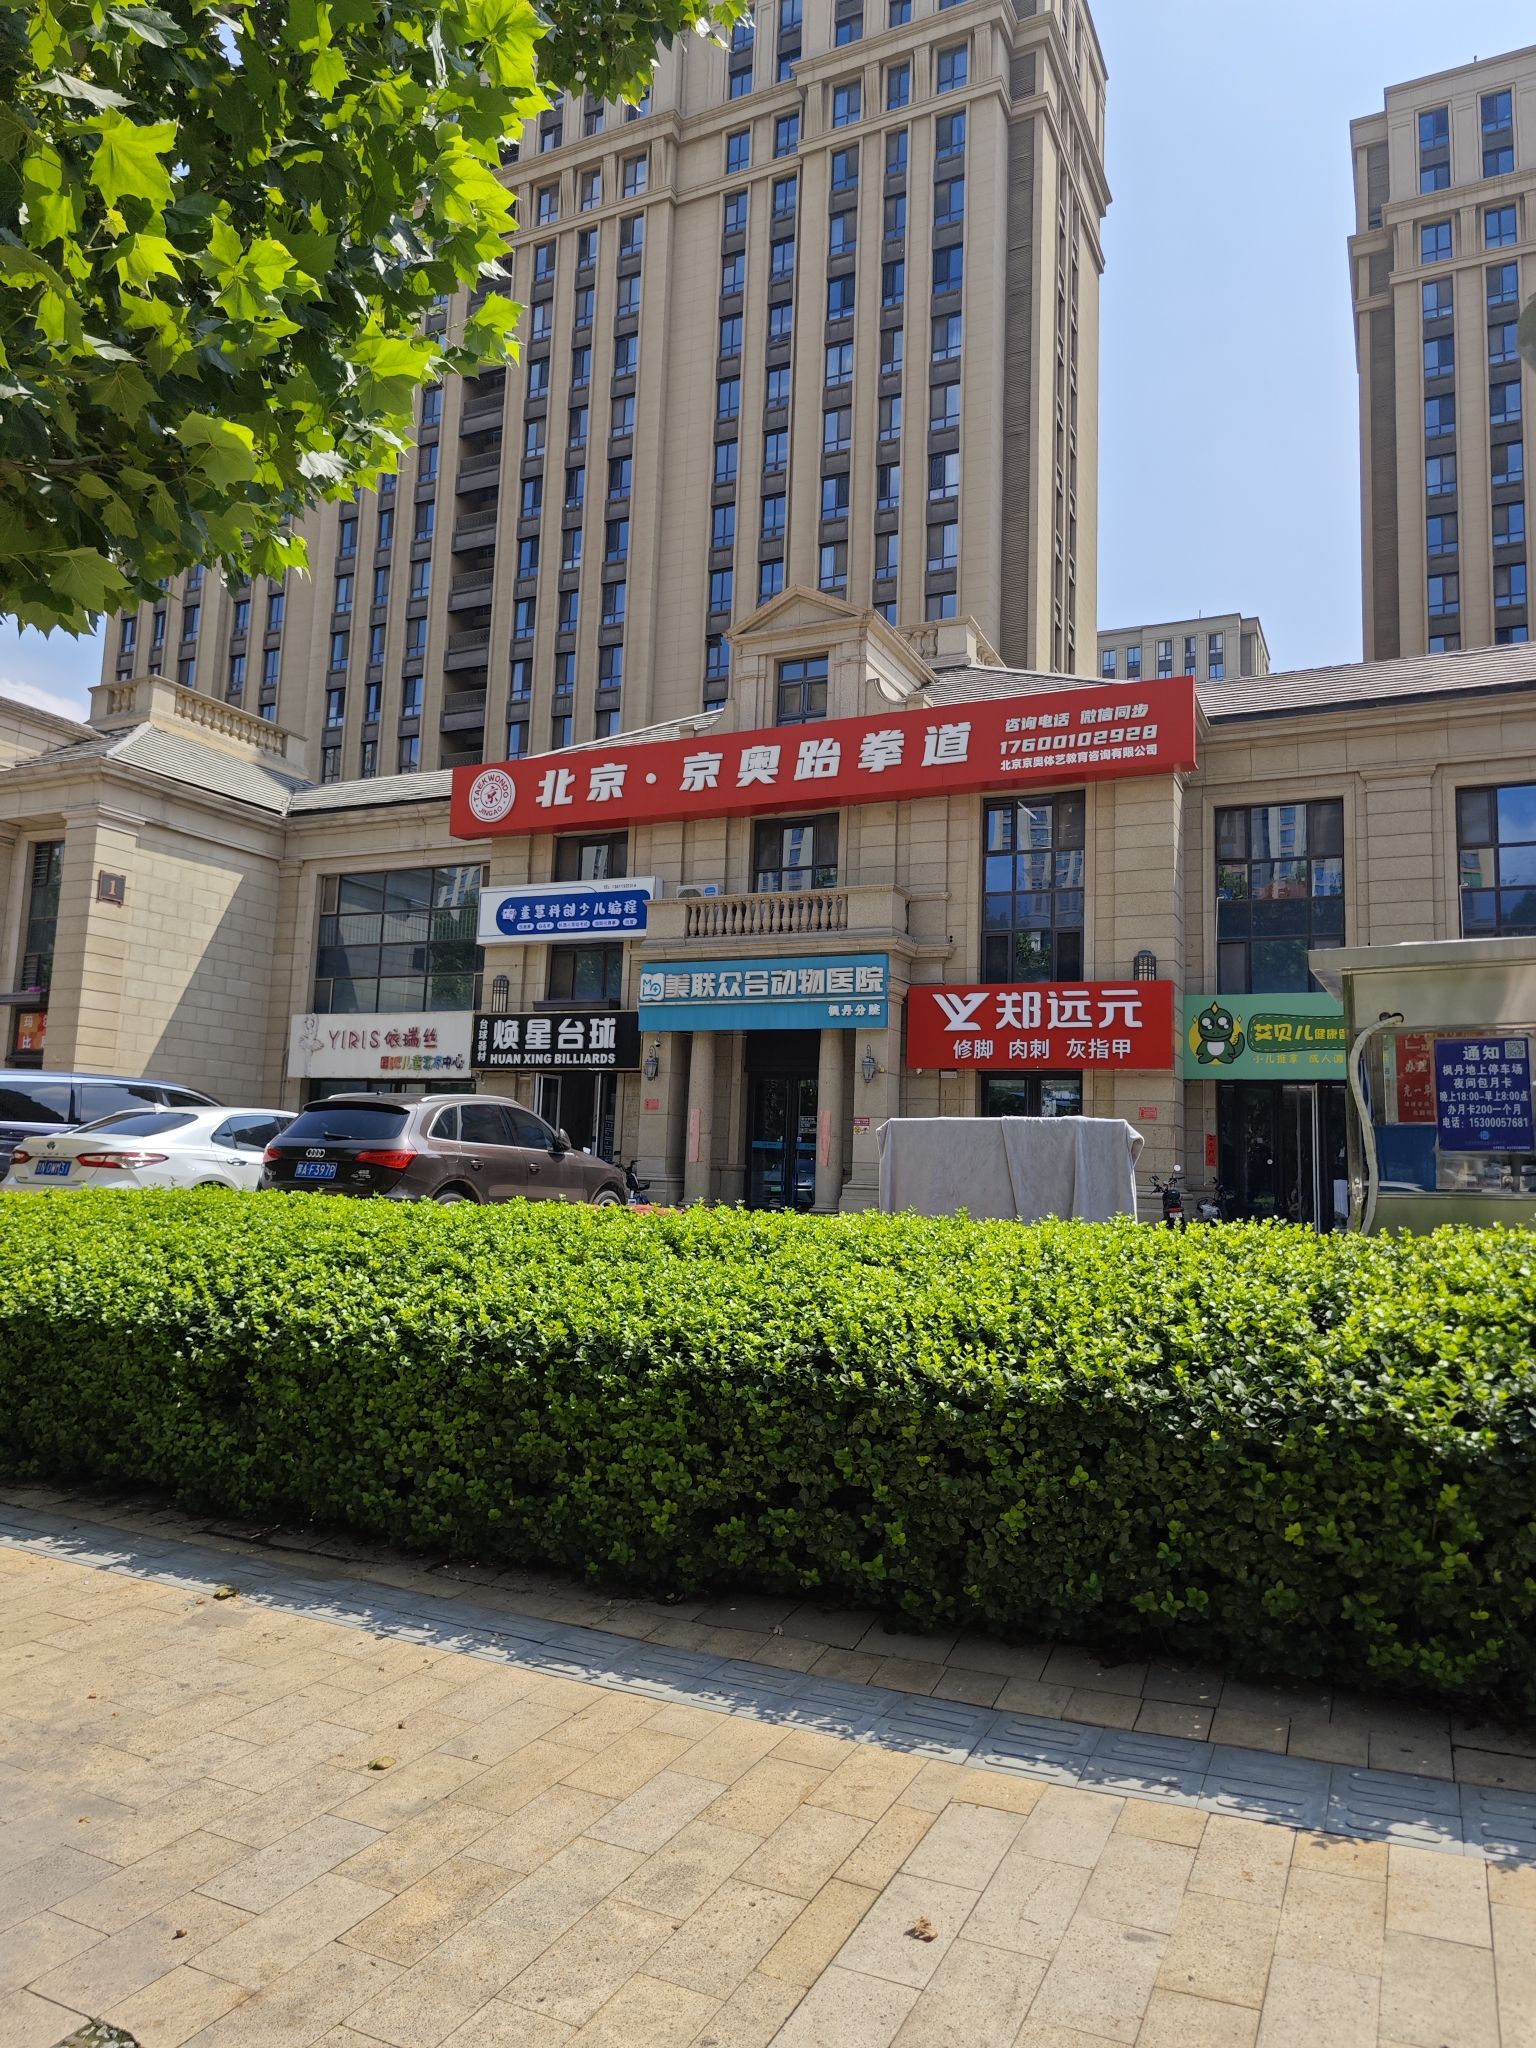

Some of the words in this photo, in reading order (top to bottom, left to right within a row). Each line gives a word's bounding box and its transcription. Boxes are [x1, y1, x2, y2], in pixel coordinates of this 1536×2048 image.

[1005, 713, 1070, 732] 咨询电话
[1080, 704, 1149, 724] 微信同步
[1000, 725, 1158, 754] 17600102928
[1000, 744, 1158, 771] 北京京奥体艺教育咨询有限公司
[473, 774, 509, 802] TAEKWONDO
[478, 805, 503, 817] JINGAO
[108, 880, 117, 896] 1
[664, 966, 884, 998] 美联众合动物医院
[828, 1004, 881, 1017] 枫丹分院
[995, 989, 1143, 1030] 郑远元
[329, 1029, 380, 1050] YIRIS
[477, 1018, 489, 1062] 台球器材
[492, 1018, 617, 1050] 焕星台球
[490, 1054, 521, 1065] HUAN
[523, 1054, 551, 1064] XING
[554, 1053, 616, 1064] BILLIARDS
[953, 1039, 994, 1059] 修脚
[1008, 1039, 1050, 1059] 肉刺
[1066, 1039, 1131, 1059] 灰指甲
[1253, 1053, 1298, 1064] 小儿推拿
[1463, 1045, 1499, 1061] 通知
[1442, 1063, 1523, 1076] 枫丹地上停车场
[1453, 1077, 1513, 1089] 夜间包月卡
[1447, 1104, 1521, 1116] 办月卡200一个月
